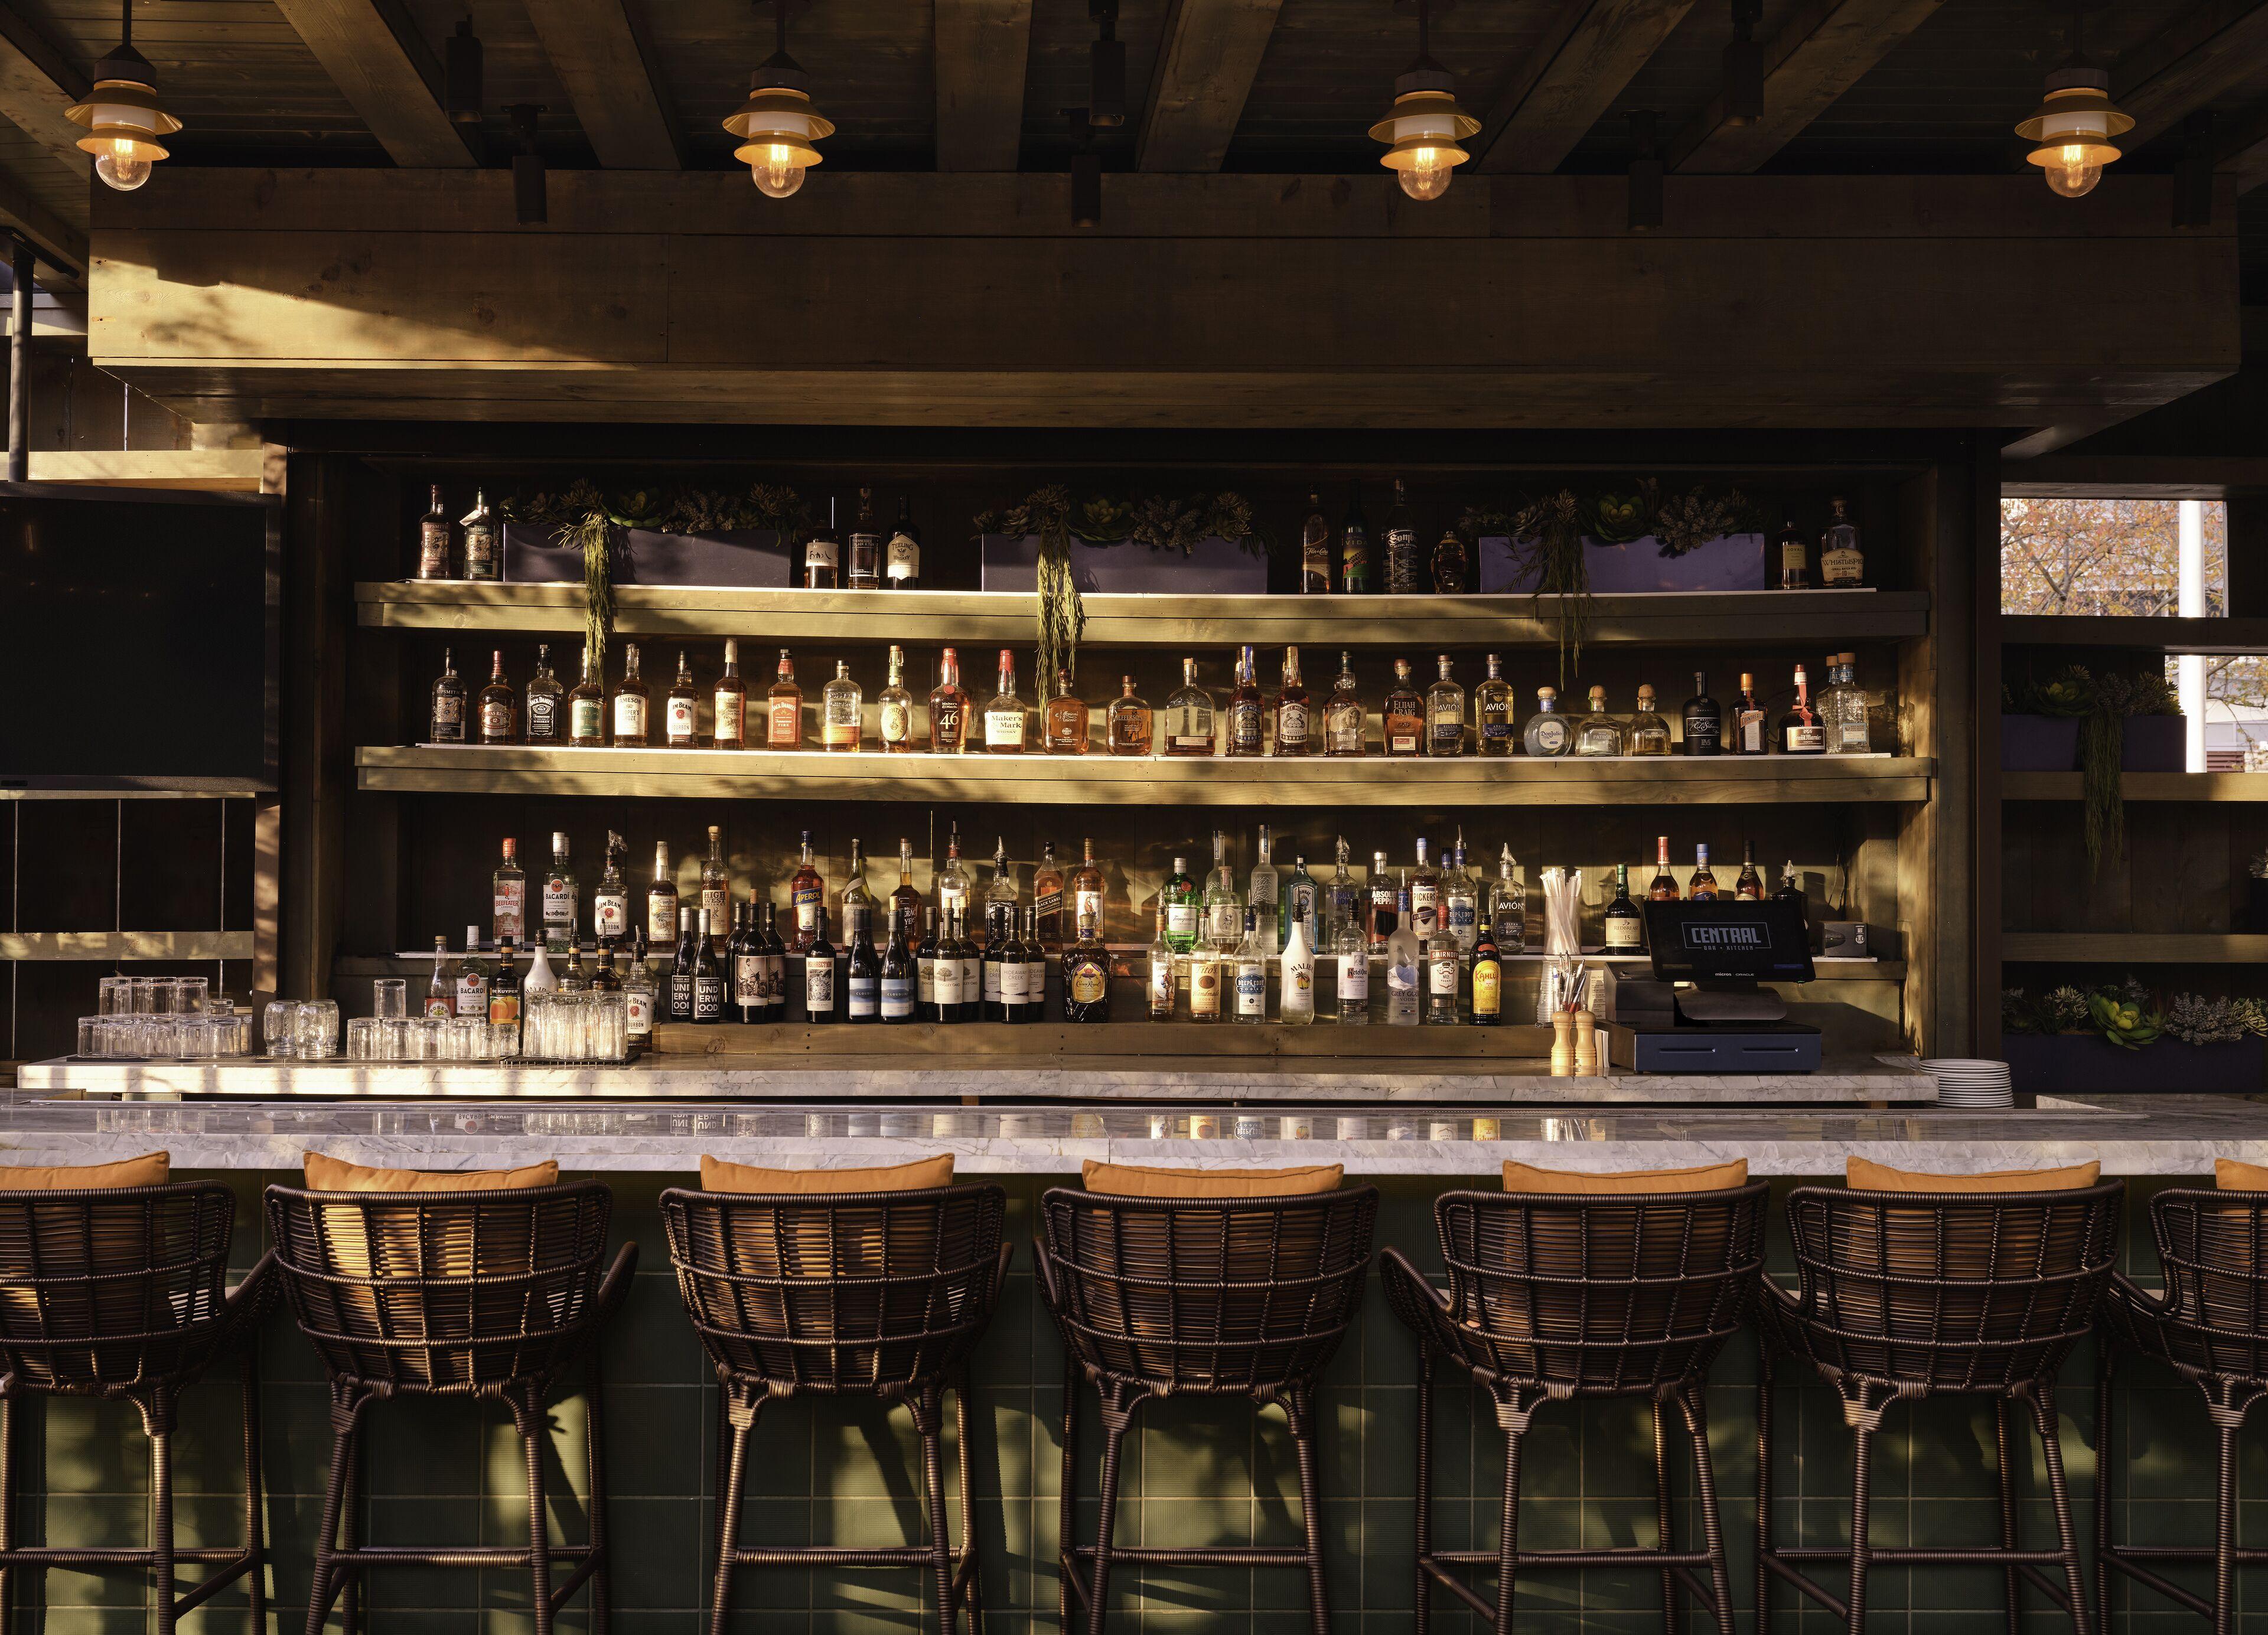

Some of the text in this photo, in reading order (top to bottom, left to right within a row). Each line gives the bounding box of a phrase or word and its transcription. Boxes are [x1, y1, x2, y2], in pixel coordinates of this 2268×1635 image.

[891, 542, 914, 551] TEELING
[679, 701, 692, 712] BEAM
[772, 701, 796, 712] JACK DANIEL'S
[1438, 703, 1462, 712] AVIÓN
[1485, 702, 1511, 711] AVIÓN
[1394, 708, 1415, 716] CRAIG
[940, 710, 959, 729] 46
[1299, 887, 1311, 896] OMBAY
[796, 891, 820, 903] APEROL
[1413, 893, 1436, 901] PICKERS
[598, 899, 621, 910] JIM BEAM
[1498, 901, 1524, 910] AVIÓN
[1691, 928, 1762, 944] CENTRAL
[1196, 965, 1218, 974] Tito's
[1348, 968, 1361, 977] Ketel
[1076, 980, 1100, 988] Crown Royal
[633, 997, 647, 1009] BEAM
